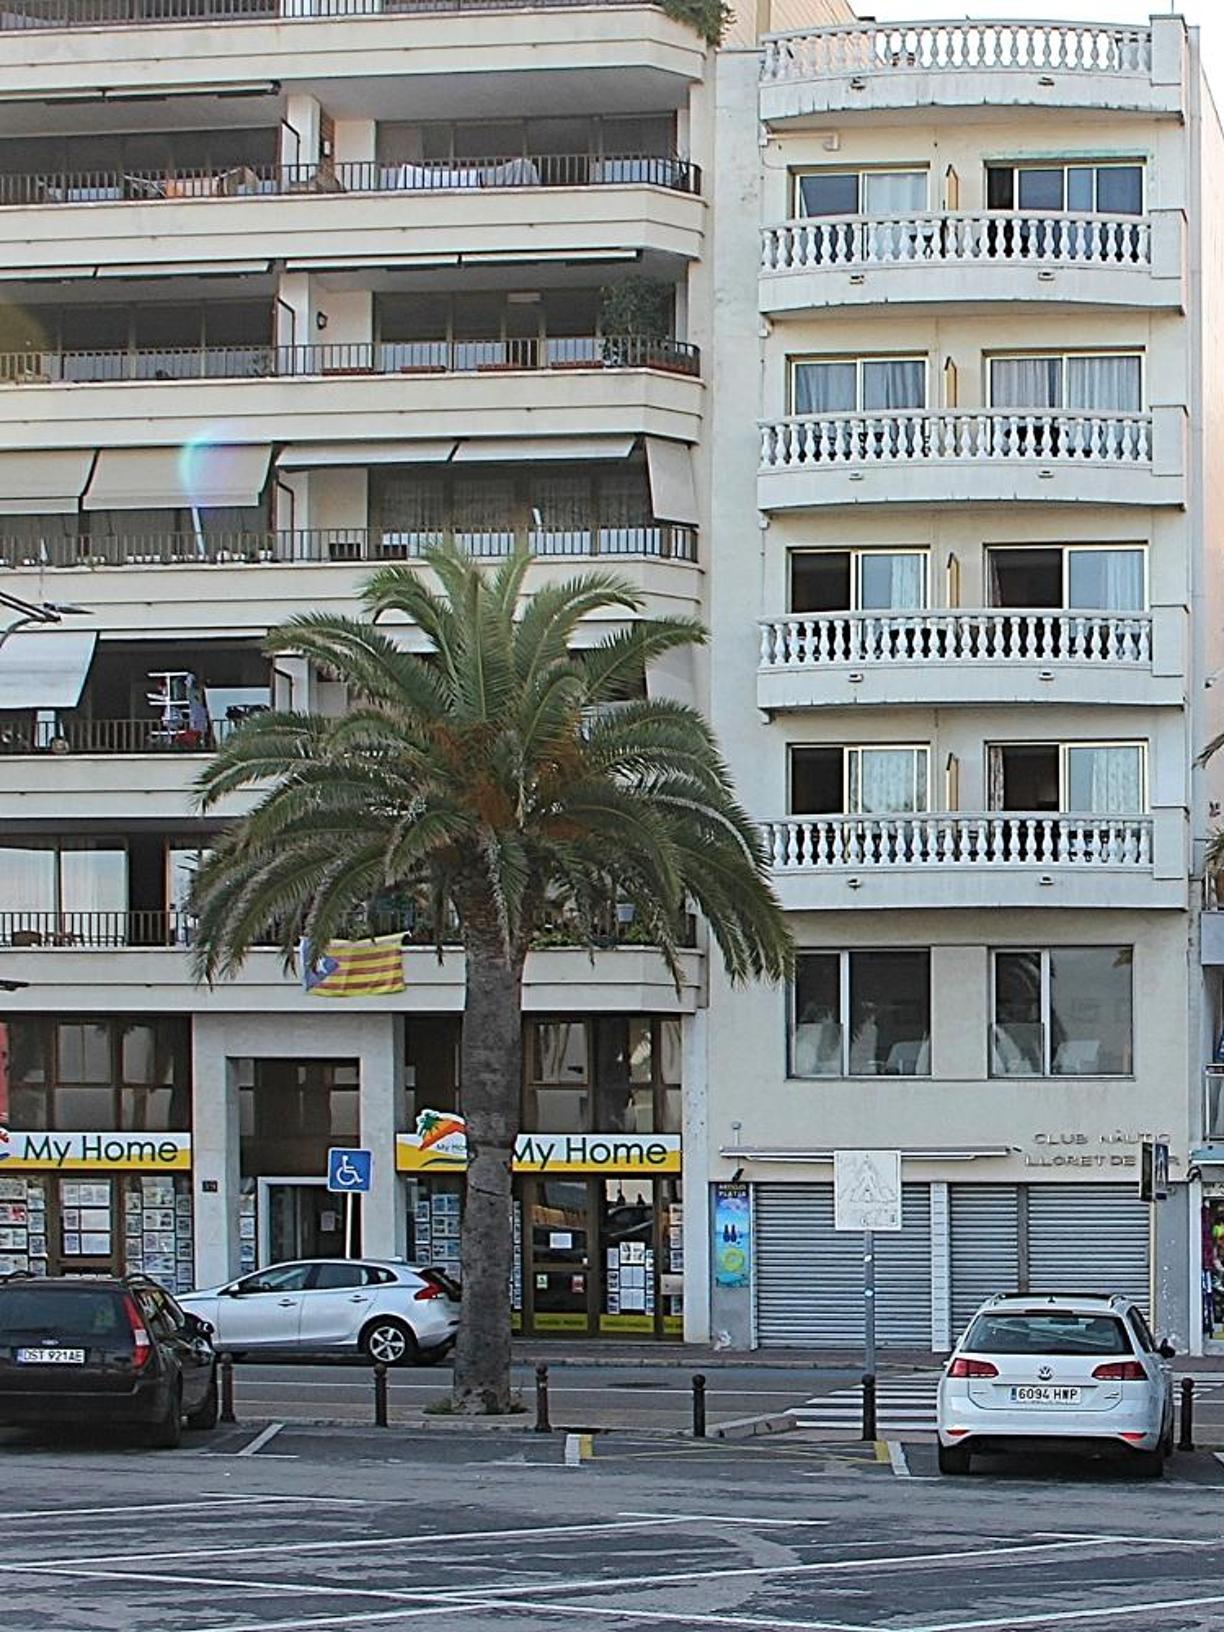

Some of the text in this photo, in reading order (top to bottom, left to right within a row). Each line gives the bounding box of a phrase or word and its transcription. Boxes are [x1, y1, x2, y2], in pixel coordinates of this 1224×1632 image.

[1034, 1133, 1088, 1145] CLUB
[24, 1135, 178, 1167] My Home
[515, 1137, 667, 1169] My Home
[1025, 1154, 1106, 1167] LLORET
[1110, 1154, 1137, 1167] DE
[1018, 1388, 1050, 1400] 6094
